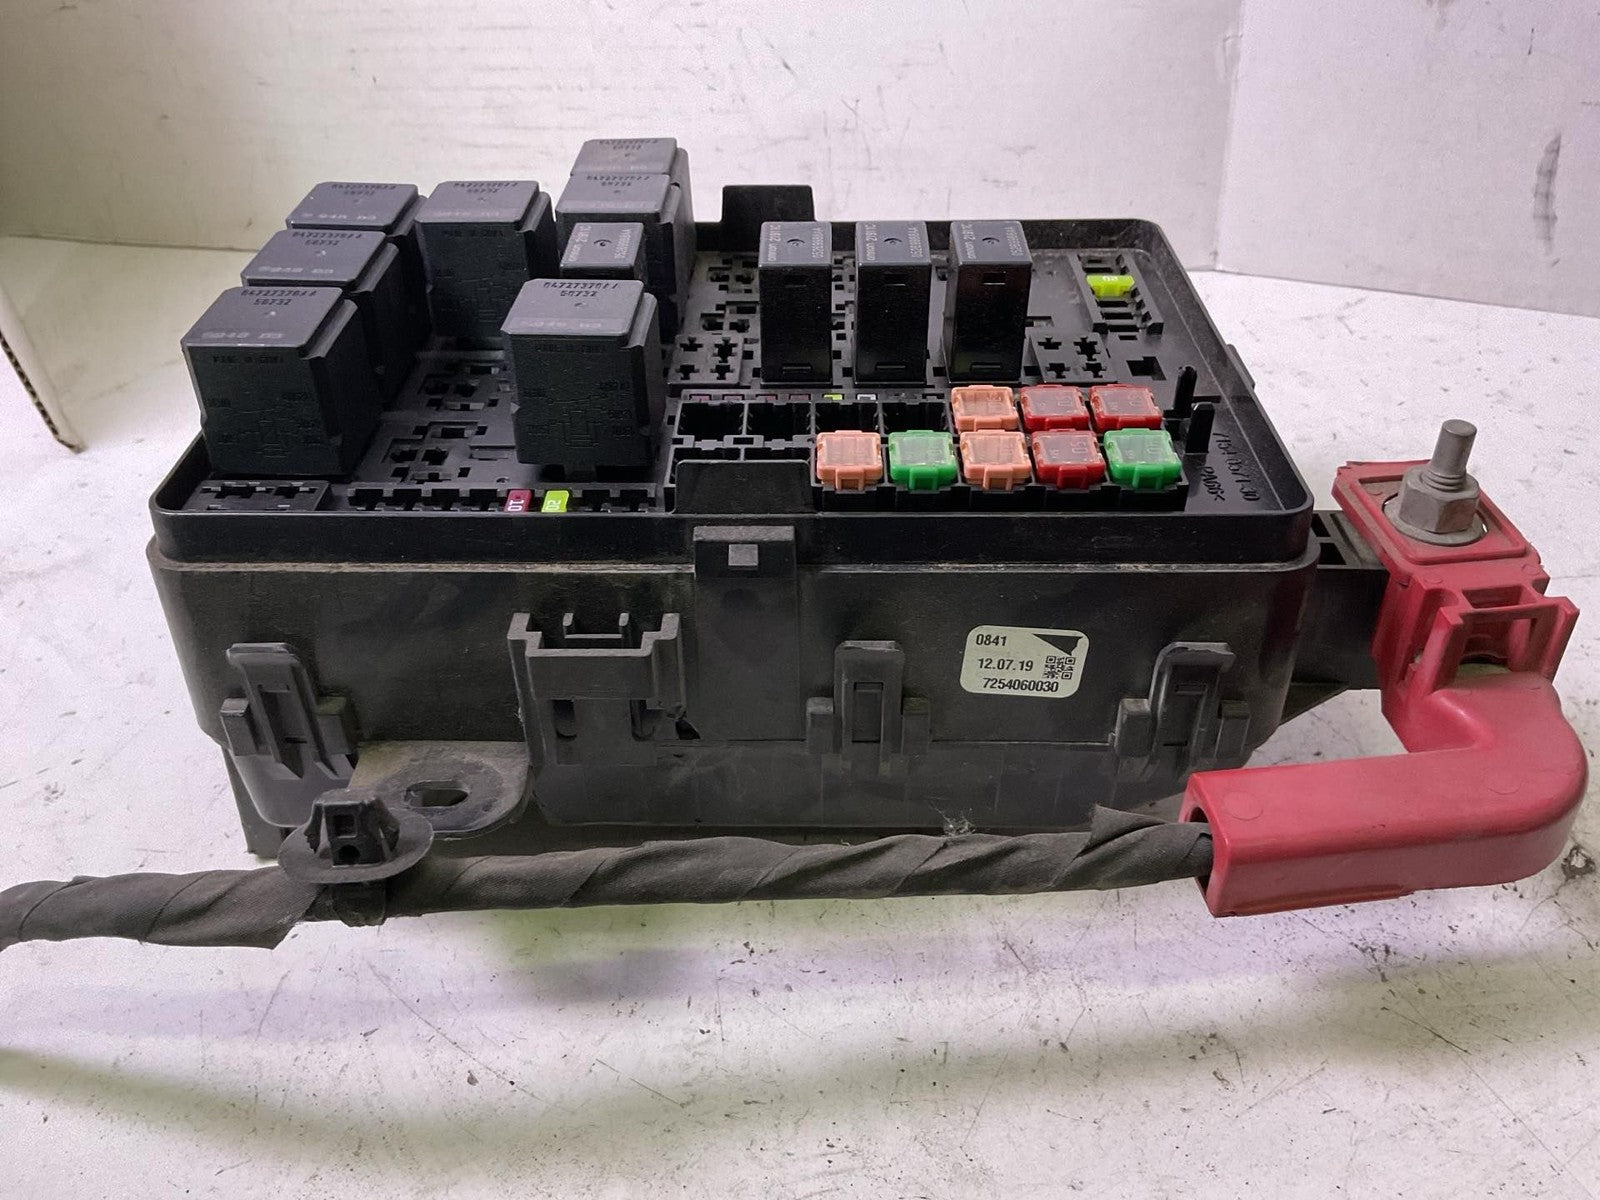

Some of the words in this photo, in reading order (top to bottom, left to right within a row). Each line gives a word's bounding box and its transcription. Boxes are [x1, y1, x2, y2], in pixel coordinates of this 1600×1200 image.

[507, 499, 524, 512] 10
[975, 633, 1007, 646] 0841
[978, 658, 1034, 672] 12.07.19
[982, 677, 1059, 692] 7254060030
